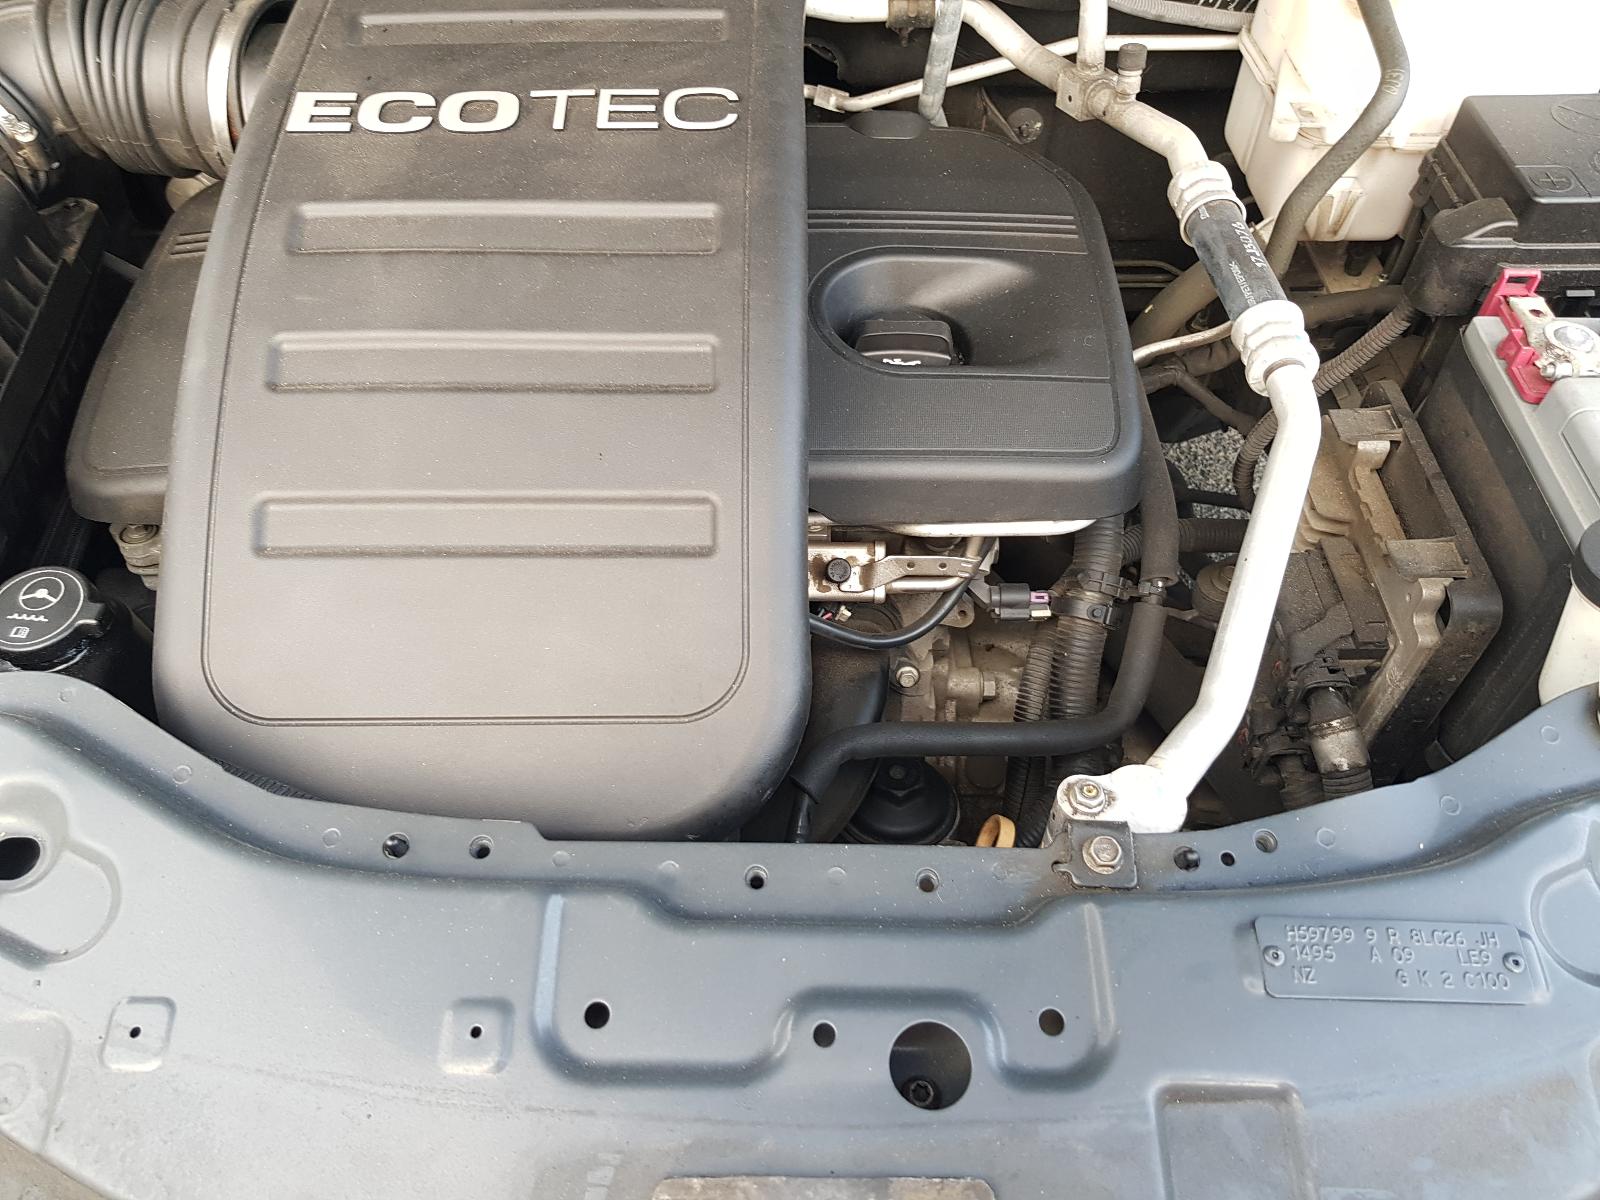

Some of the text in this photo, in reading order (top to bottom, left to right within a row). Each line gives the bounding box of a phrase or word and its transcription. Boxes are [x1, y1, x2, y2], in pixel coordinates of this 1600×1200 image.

[285, 86, 740, 133] ECOTEC
[1285, 924, 1354, 943] H59799
[1364, 926, 1377, 944] 9
[1386, 927, 1401, 945] R
[1290, 944, 1492, 967] 1495 A 09 LE9
[1292, 965, 1318, 985] NZ
[1416, 969, 1432, 988] K
[1440, 970, 1455, 989] 2
[1463, 971, 1511, 990] C100
